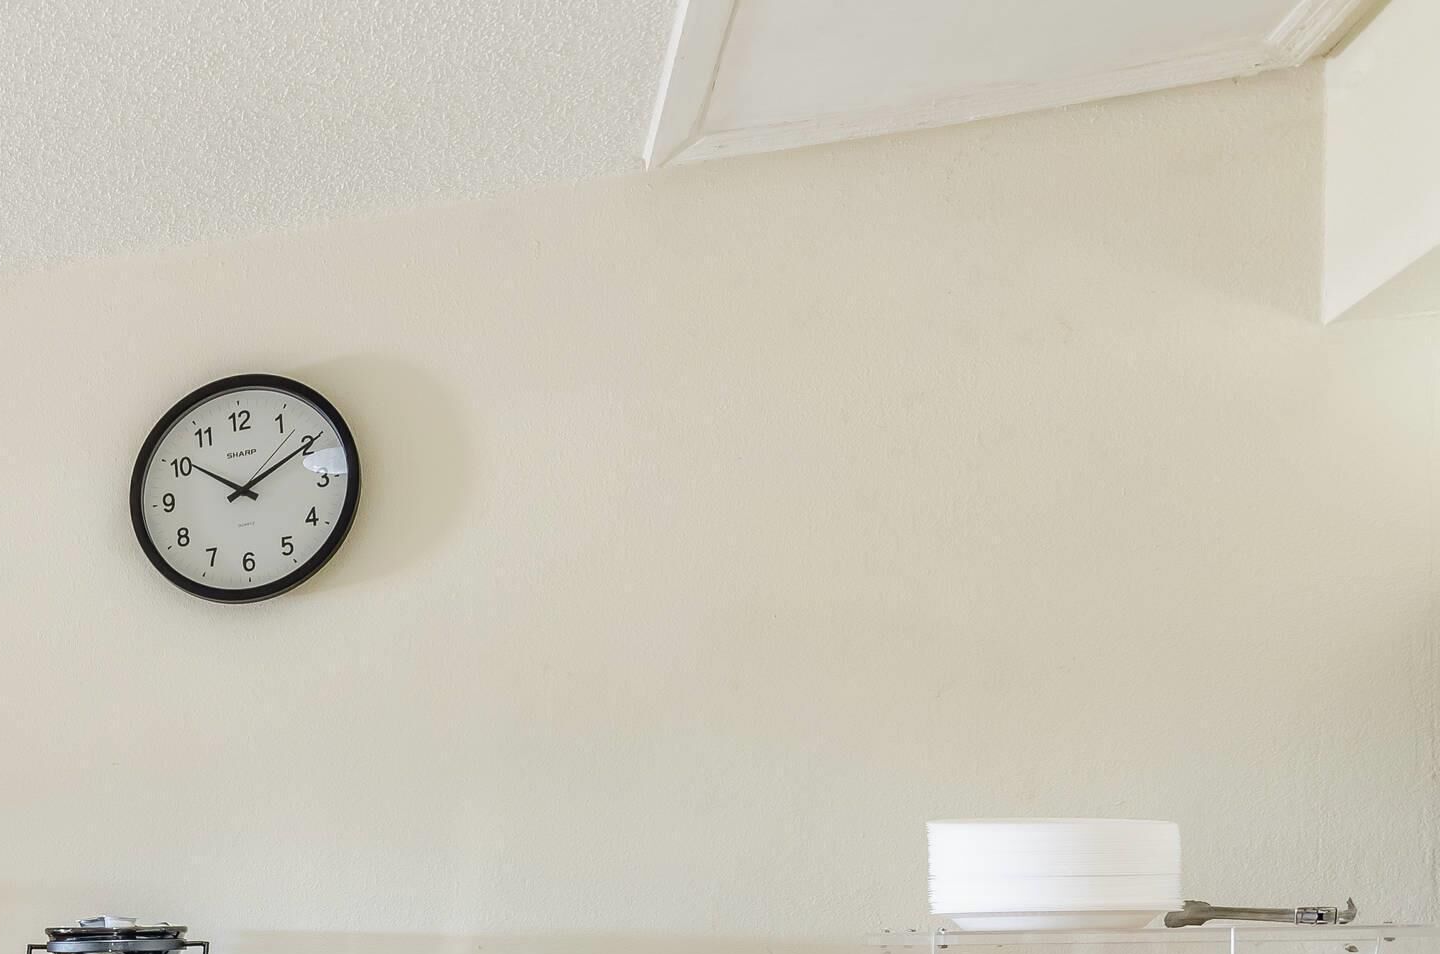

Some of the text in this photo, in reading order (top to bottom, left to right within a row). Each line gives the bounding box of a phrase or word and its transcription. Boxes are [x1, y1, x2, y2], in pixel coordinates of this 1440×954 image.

[228, 410, 250, 432] 12
[274, 414, 284, 434] 1
[194, 427, 212, 448] 11
[302, 435, 314, 456] 2
[226, 448, 257, 459] SHARP
[170, 456, 192, 478] 10
[317, 468, 330, 487] 3
[162, 493, 175, 512] 9
[305, 506, 319, 526] 4
[177, 528, 190, 547] 8
[281, 536, 294, 556] 5
[206, 548, 217, 567] 7
[242, 552, 255, 572] 6
